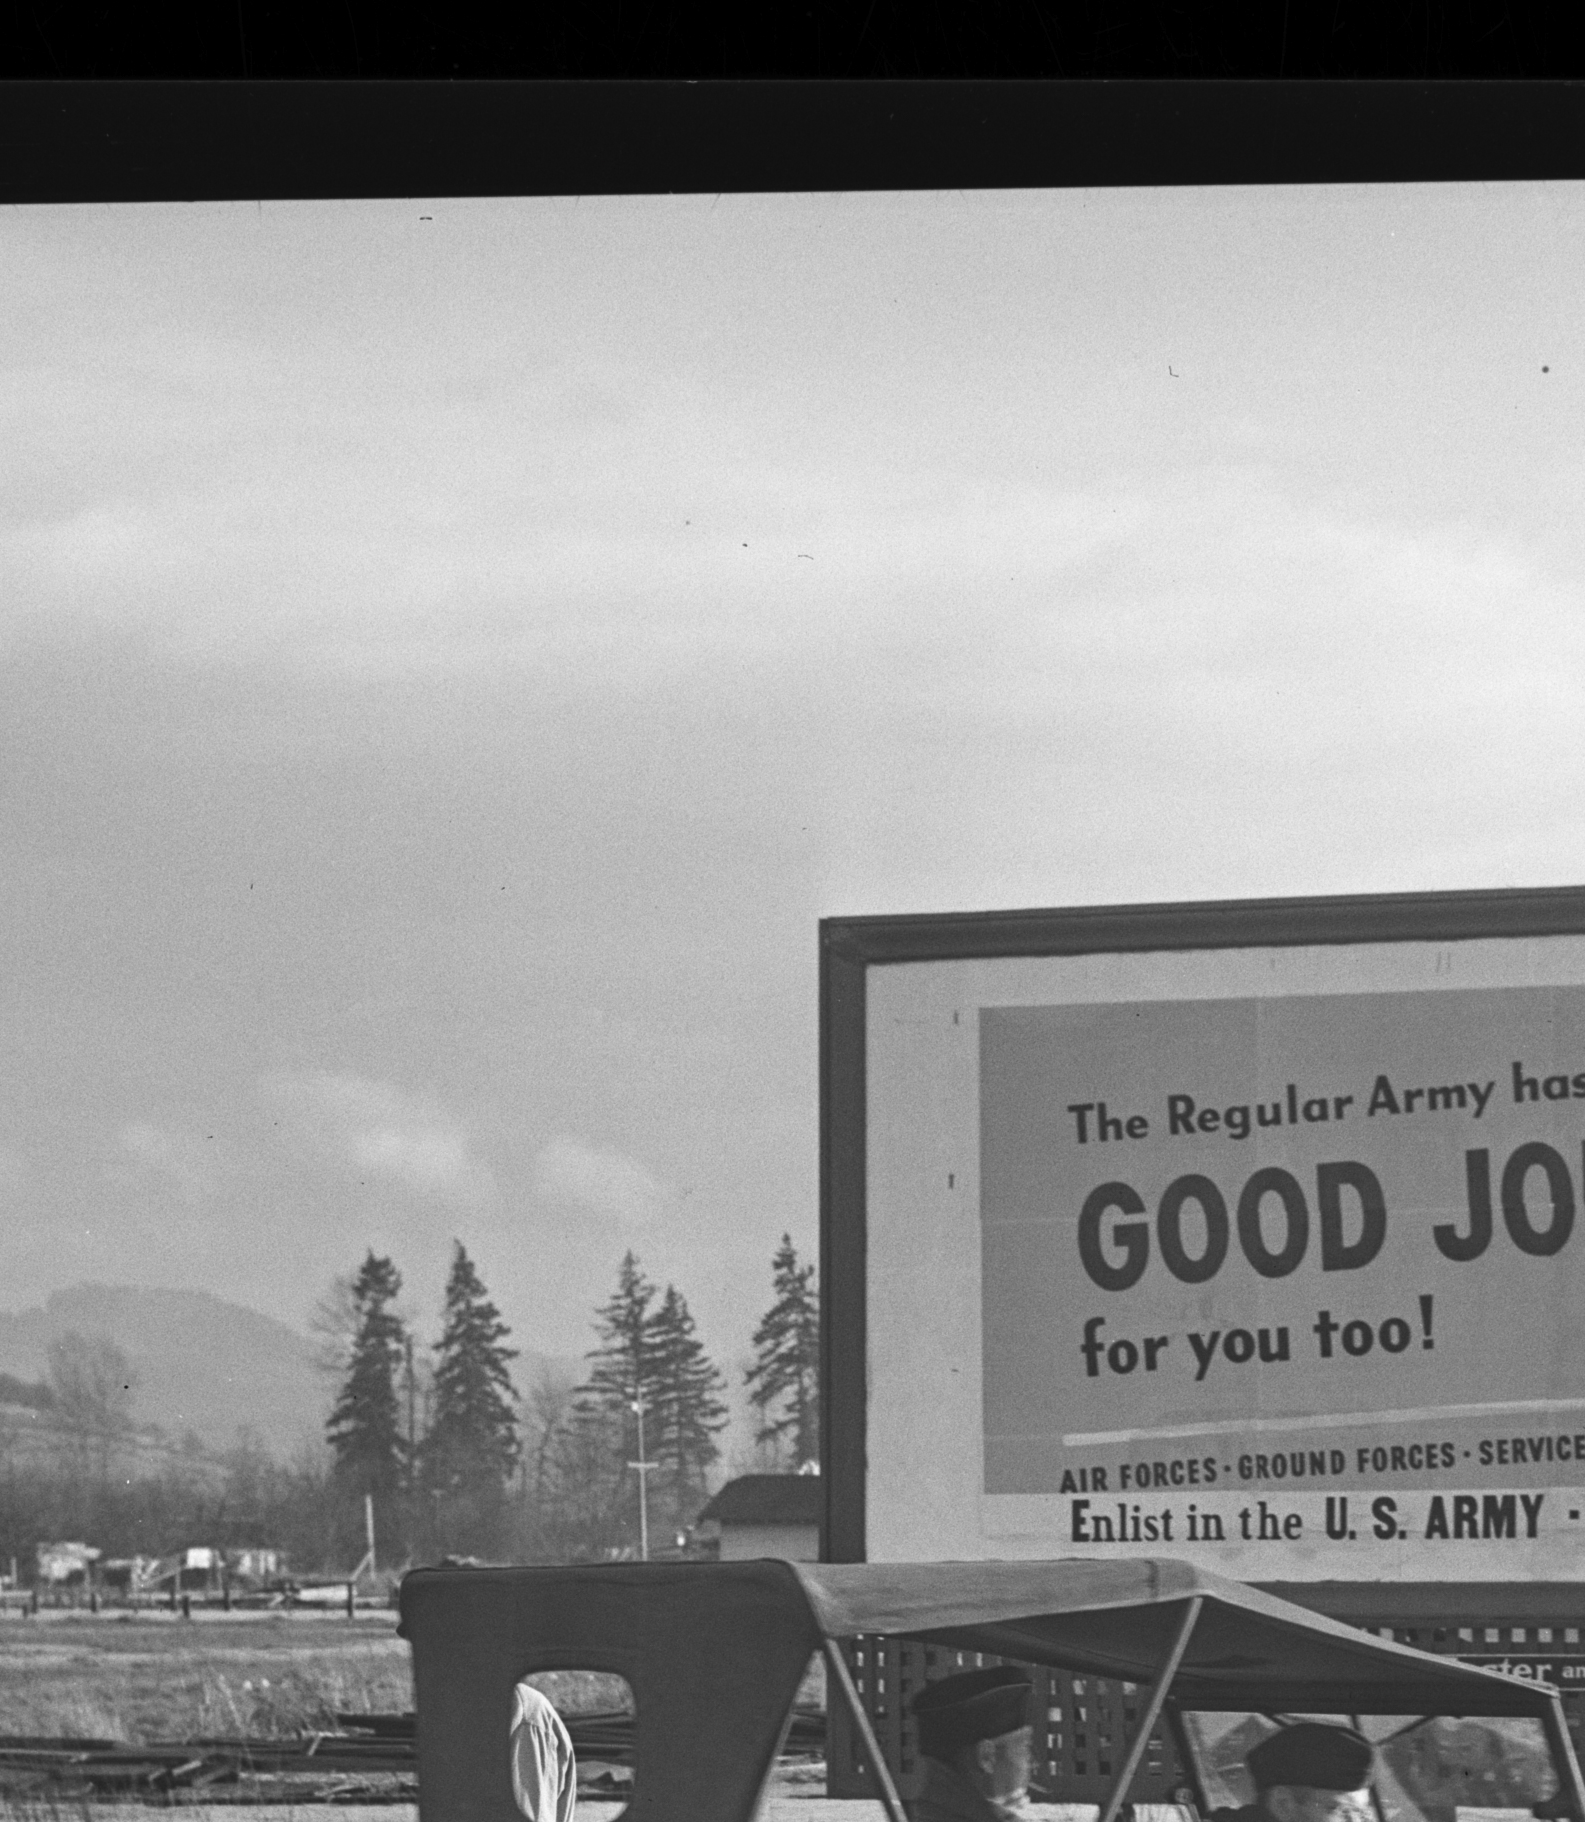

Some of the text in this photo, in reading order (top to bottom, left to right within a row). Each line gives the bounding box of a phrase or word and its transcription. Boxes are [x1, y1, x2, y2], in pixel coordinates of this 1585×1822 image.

[1066, 1101, 1149, 1145] The
[1167, 1083, 1354, 1141] Regular
[1367, 1074, 1495, 1119] Army
[1077, 1160, 1388, 1292] GOOD
[1080, 1294, 1434, 1382] for you too!
[1058, 1465, 1110, 1494] AIR
[1118, 1455, 1219, 1491] FORCES
[1237, 1449, 1346, 1481] GROUND
[1356, 1442, 1456, 1474] FORCES
[1071, 1499, 1174, 1543] Enlist
[1186, 1503, 1227, 1542] in
[1238, 1500, 1303, 1541] the
[1424, 1493, 1545, 1540] ARMY
